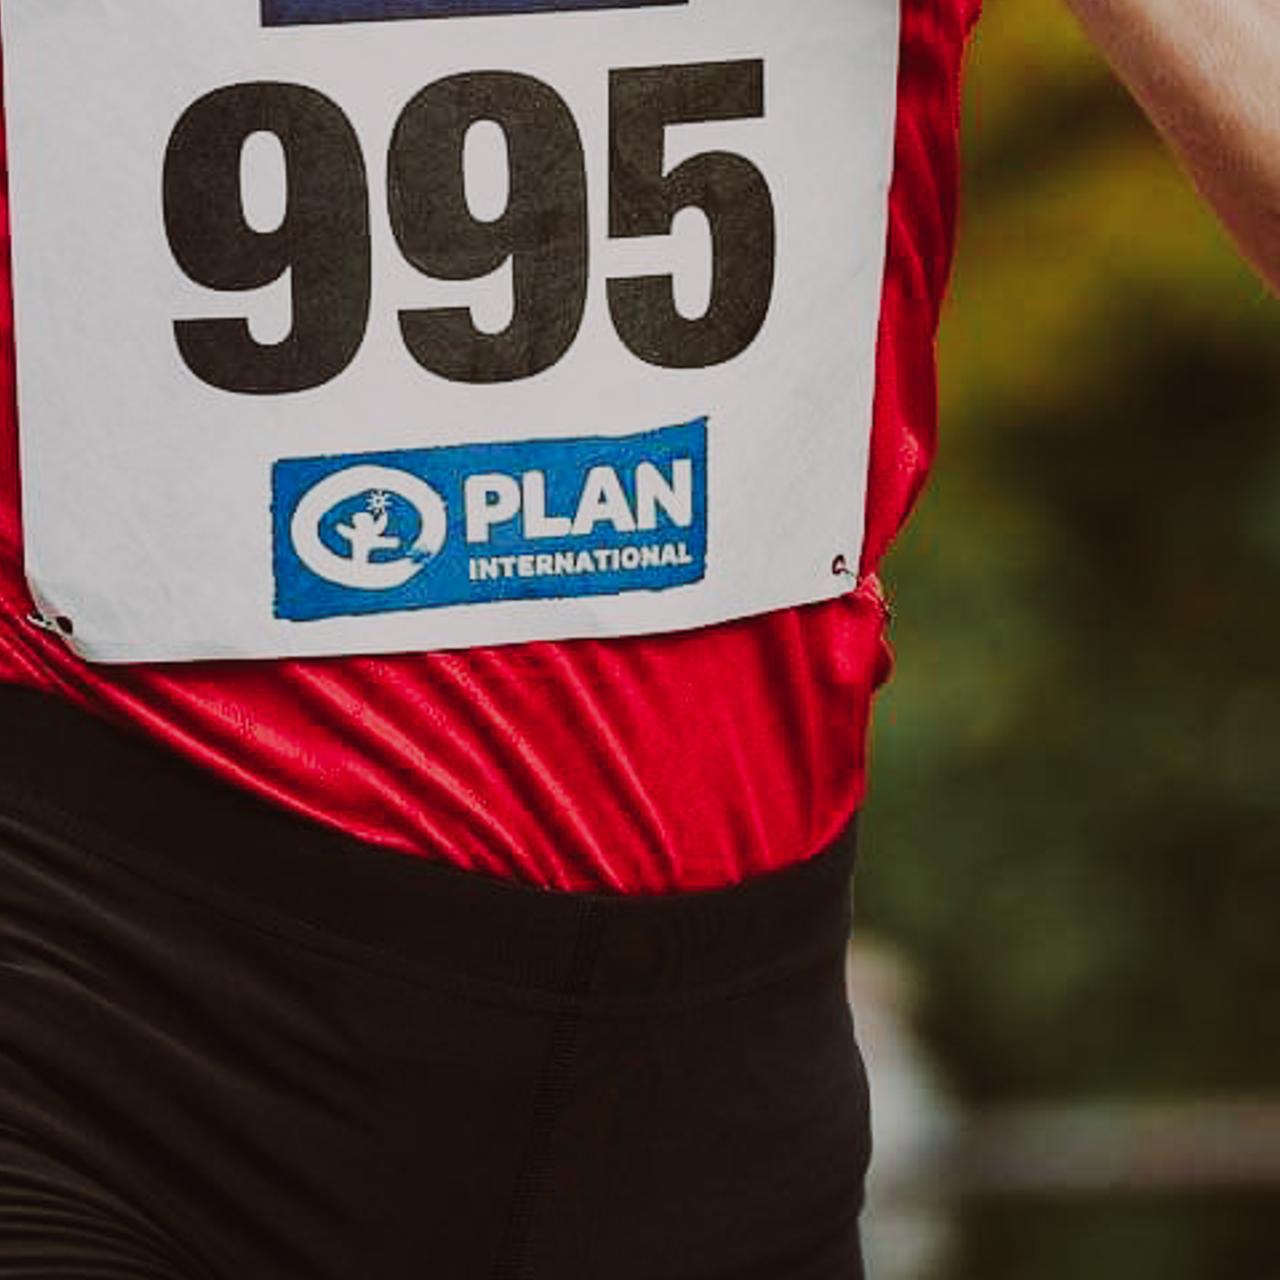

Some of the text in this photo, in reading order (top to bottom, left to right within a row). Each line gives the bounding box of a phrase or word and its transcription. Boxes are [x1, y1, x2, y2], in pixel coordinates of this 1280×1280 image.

[161, 58, 776, 396] 995
[464, 459, 693, 543] PLAN
[469, 544, 692, 580] INTERNATIONAL
